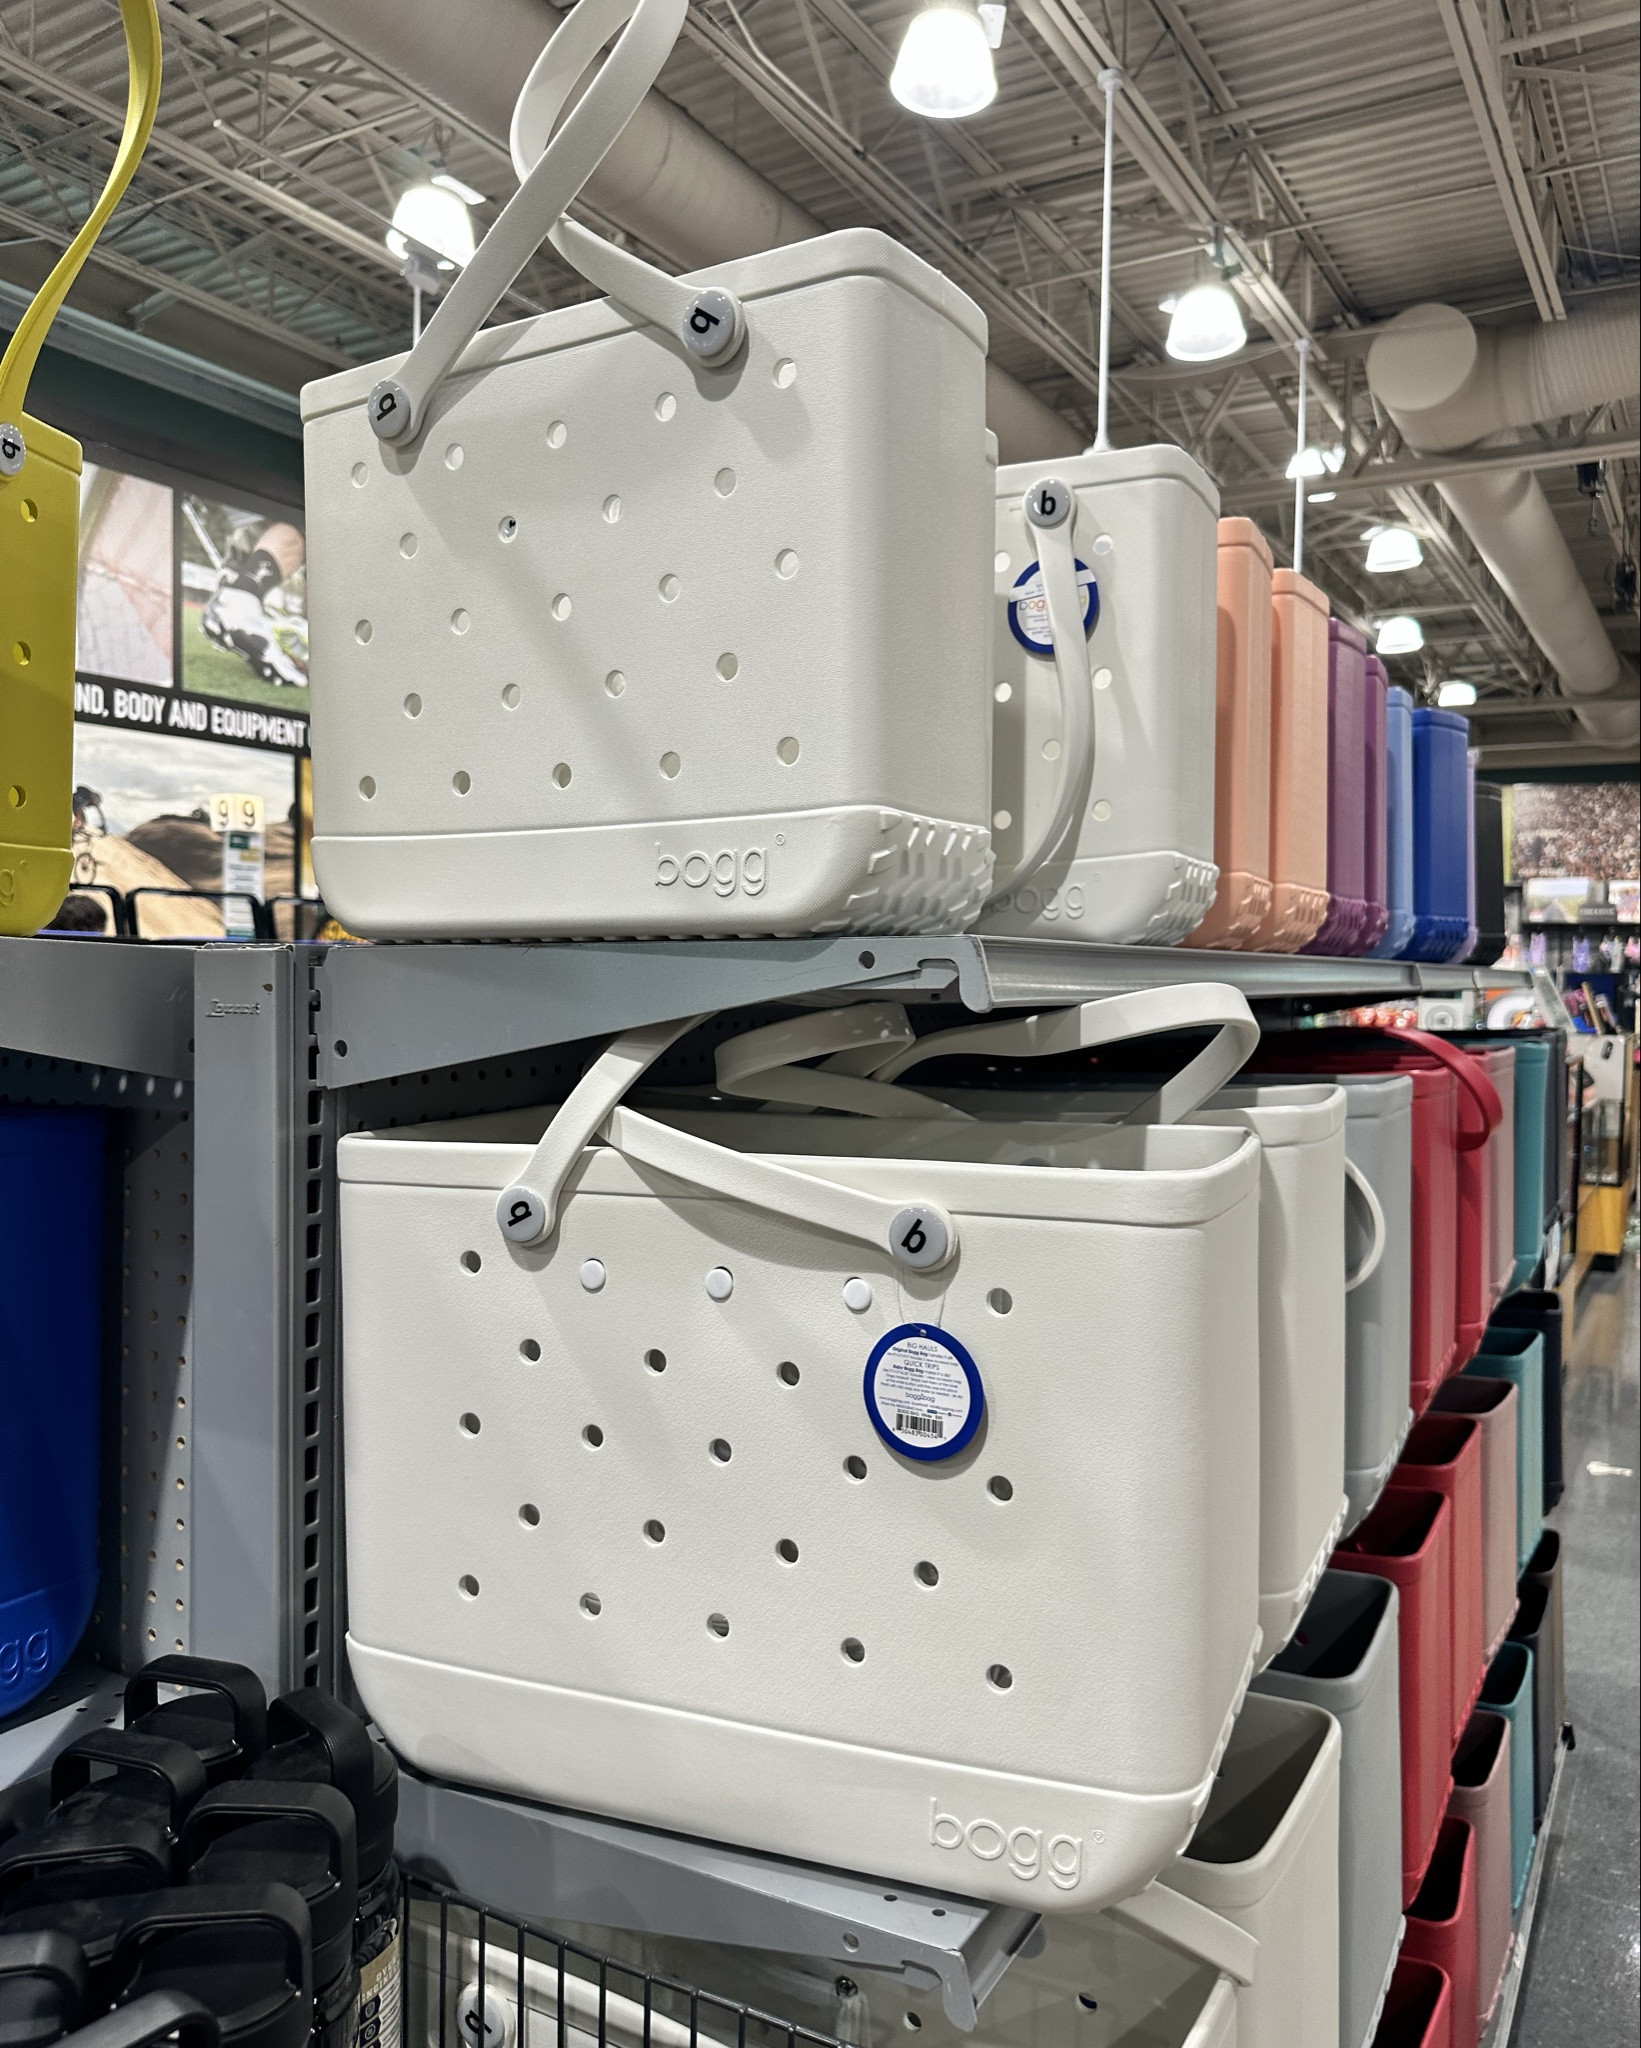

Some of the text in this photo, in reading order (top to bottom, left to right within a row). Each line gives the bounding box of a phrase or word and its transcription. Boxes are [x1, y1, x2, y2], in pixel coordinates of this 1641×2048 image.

[690, 307, 721, 334] b
[377, 392, 397, 422] b
[1040, 490, 1057, 516] b
[113, 688, 166, 725] BODY
[168, 698, 208, 732] AND
[210, 704, 308, 748] EQUIPMENT
[654, 841, 768, 898] bogg
[507, 1200, 532, 1228] b
[900, 1218, 927, 1254] b
[907, 1341, 938, 1353] BIG HAULS
[904, 1359, 923, 1369] QUICK
[924, 1361, 940, 1371] TRIPS
[930, 1797, 1083, 1891] bogg
